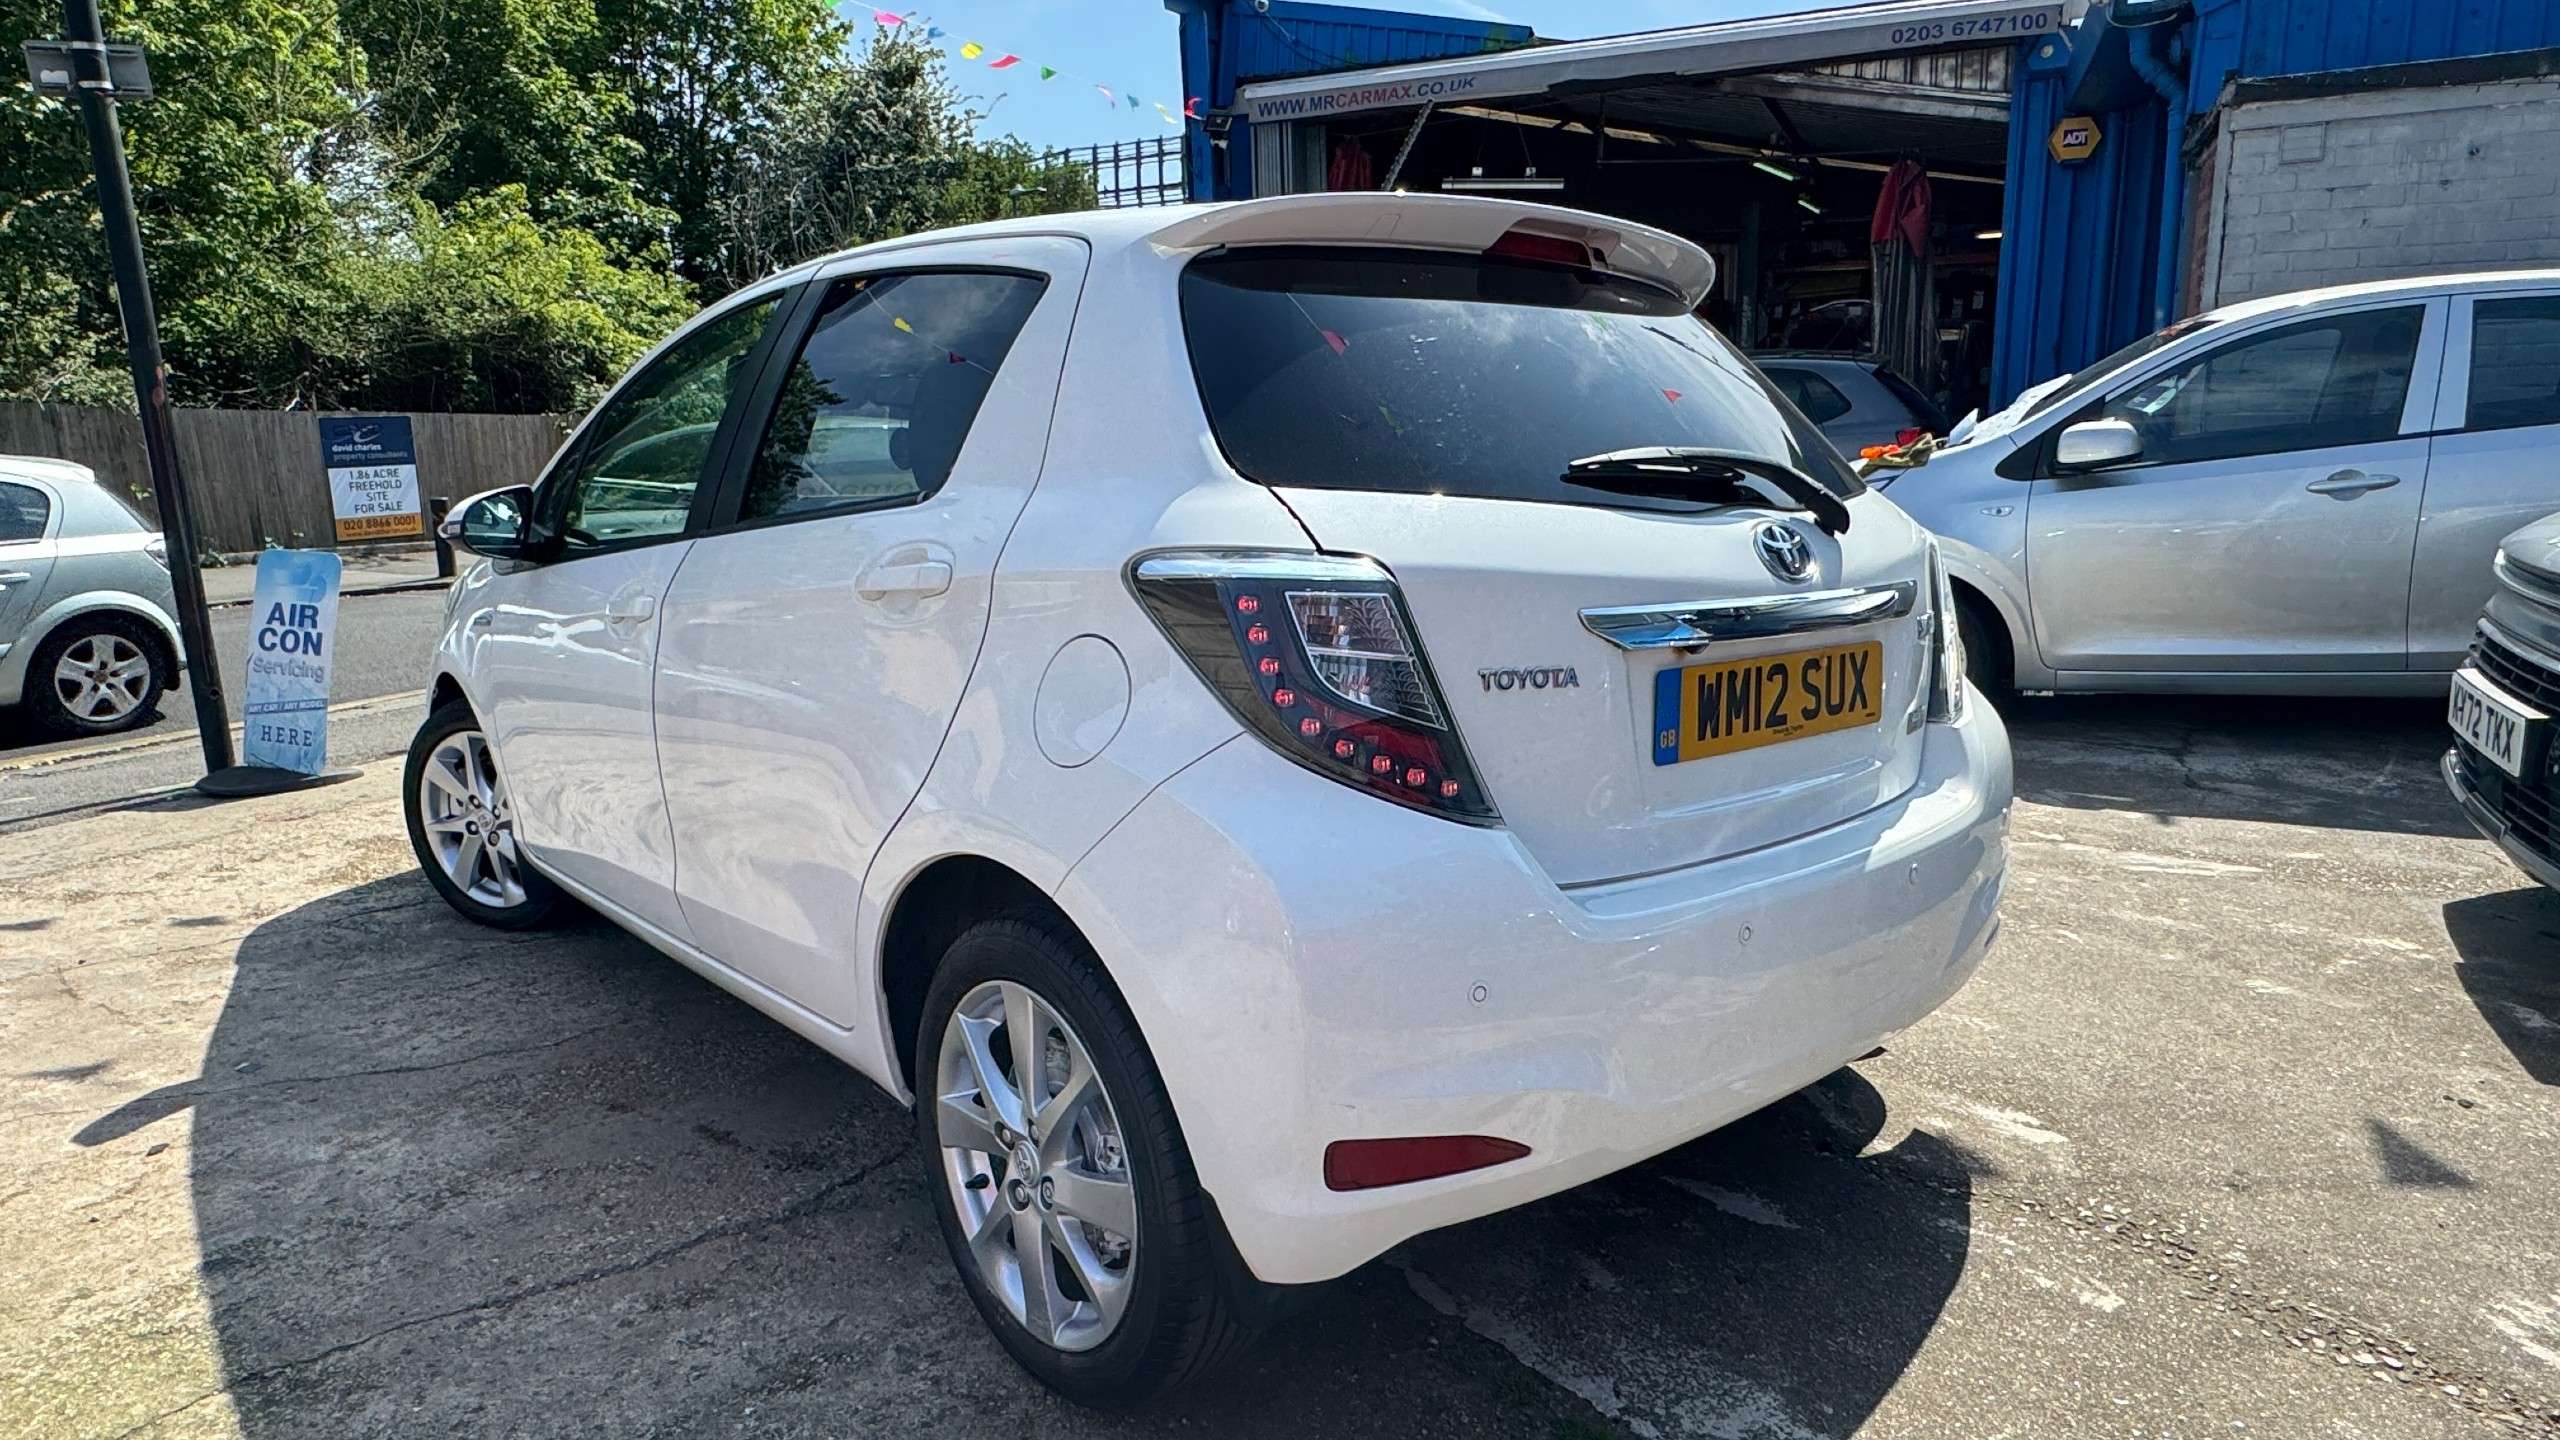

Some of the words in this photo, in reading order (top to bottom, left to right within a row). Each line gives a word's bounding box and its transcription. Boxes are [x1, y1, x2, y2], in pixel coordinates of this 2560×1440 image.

[1891, 24, 1944, 45] 0203
[1951, 13, 2049, 37] 6747100
[1258, 77, 1477, 118] WWW.MRCARMAX.CO.UK
[2063, 131, 2089, 145] ADT
[332, 444, 353, 453] david
[354, 443, 382, 452] charles
[348, 479, 402, 492] FREEHOLD
[373, 468, 400, 479] ACRE
[354, 503, 375, 514] FOR
[378, 501, 403, 512] SALE
[366, 491, 389, 502] SITE
[266, 602, 319, 629] AIR
[258, 627, 323, 656] CON
[253, 656, 325, 684] Servicing
[1478, 665, 1580, 693] TOYOTA
[1697, 663, 1789, 742] WM12
[1801, 650, 1869, 721] SUX
[261, 725, 313, 747] HERE
[1660, 729, 1676, 749] GB
[2486, 704, 2515, 764] TKX
